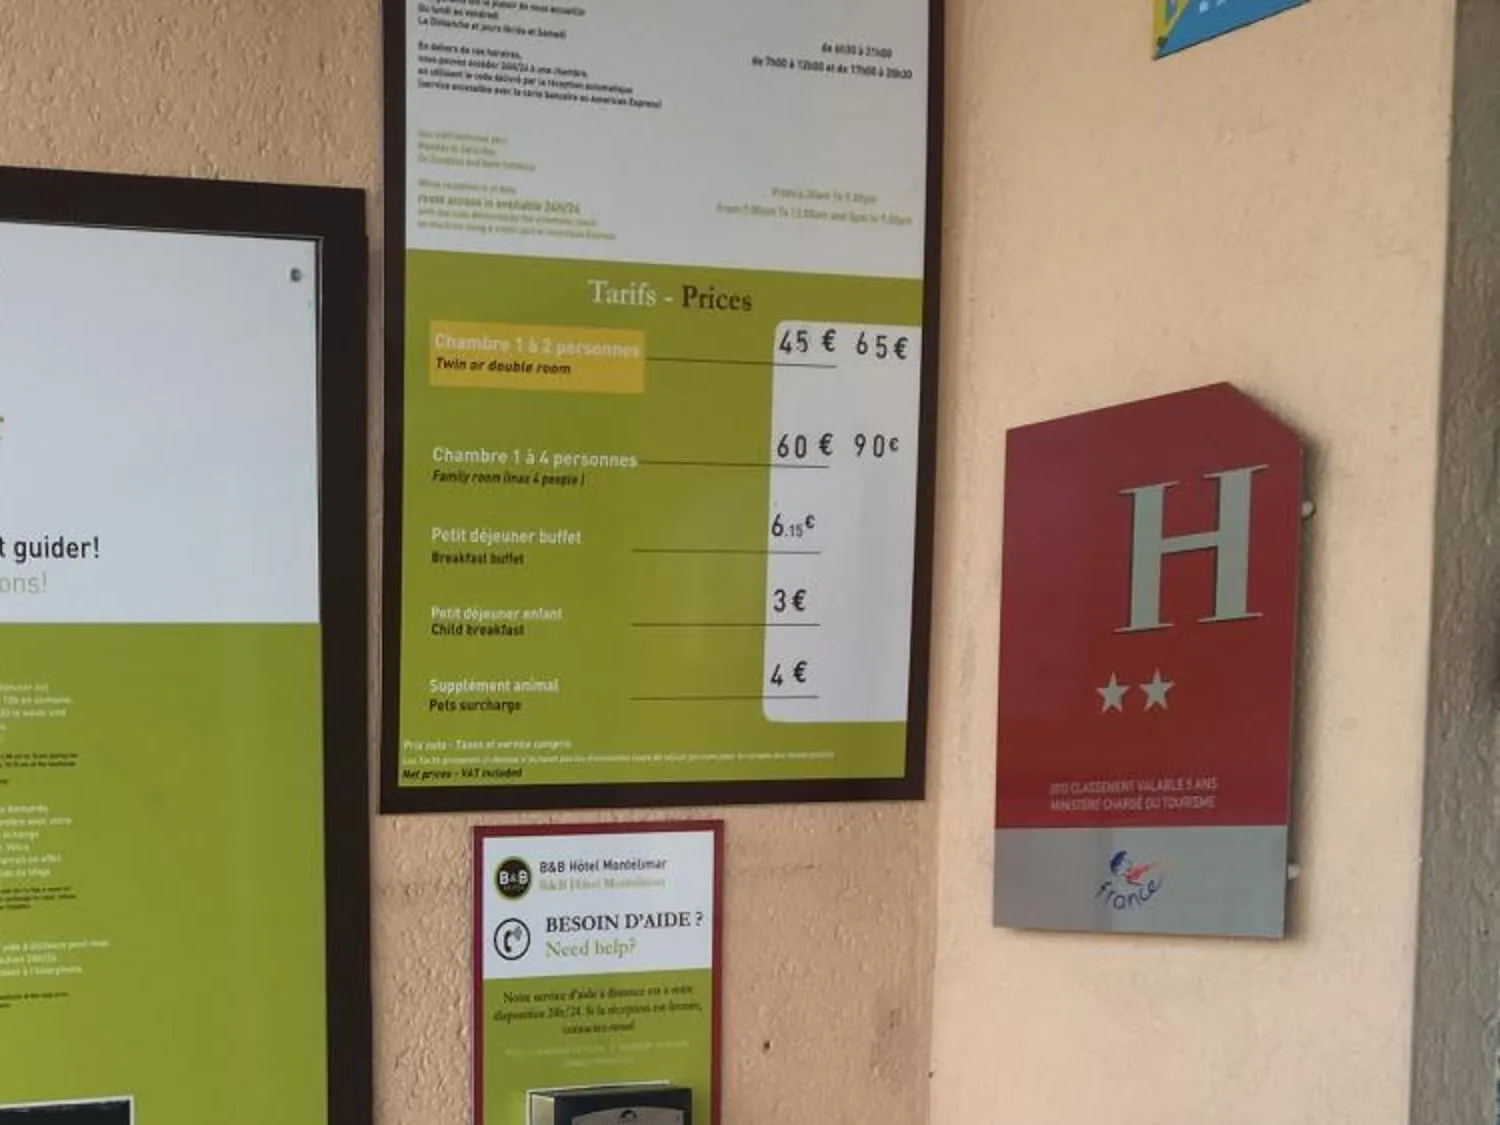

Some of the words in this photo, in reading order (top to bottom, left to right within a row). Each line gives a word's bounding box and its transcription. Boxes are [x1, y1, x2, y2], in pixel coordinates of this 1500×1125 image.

[588, 277, 657, 308] Tarifs
[682, 284, 753, 312] Prices
[434, 332, 511, 353] Chambre
[515, 335, 523, 353] 1
[527, 335, 539, 354] à
[541, 337, 552, 354] 2
[555, 340, 642, 360] personnes
[779, 328, 809, 354] 45
[821, 329, 837, 352] €
[436, 357, 465, 371] Twin
[469, 361, 484, 373] or
[487, 359, 533, 374] double
[536, 363, 572, 376] room
[777, 433, 807, 459] 60
[819, 433, 834, 456] €
[433, 447, 508, 465] Chambre
[513, 448, 520, 465] 1
[525, 448, 536, 465] à
[539, 449, 550, 465] 4
[553, 453, 638, 470] personnes
[431, 527, 465, 545] Petit
[469, 526, 535, 548] déjeuner
[538, 528, 582, 545] buffet
[1114, 464, 1268, 633] H
[13, 536, 101, 566] guider!
[431, 551, 487, 566] Breakfast
[490, 552, 524, 566] buffet
[773, 589, 787, 613] 3
[792, 589, 807, 612] €
[431, 606, 461, 621] Petit
[463, 606, 520, 625] déjeuner
[522, 607, 563, 621] enfant
[431, 624, 463, 637] Child
[466, 624, 524, 637] breakfast
[770, 663, 784, 687] 4
[794, 660, 808, 684] €
[429, 678, 510, 697] Supplément
[514, 678, 559, 694] animal
[429, 699, 457, 713] Pets
[459, 701, 522, 715] surcharge
[539, 861, 566, 874] B&B
[569, 859, 600, 873] Hôtel
[603, 857, 668, 872] Montélimar
[546, 913, 620, 934] BESOIN
[625, 911, 691, 931] D'AIDE
[545, 940, 589, 959] Need
[594, 938, 637, 960] help?
